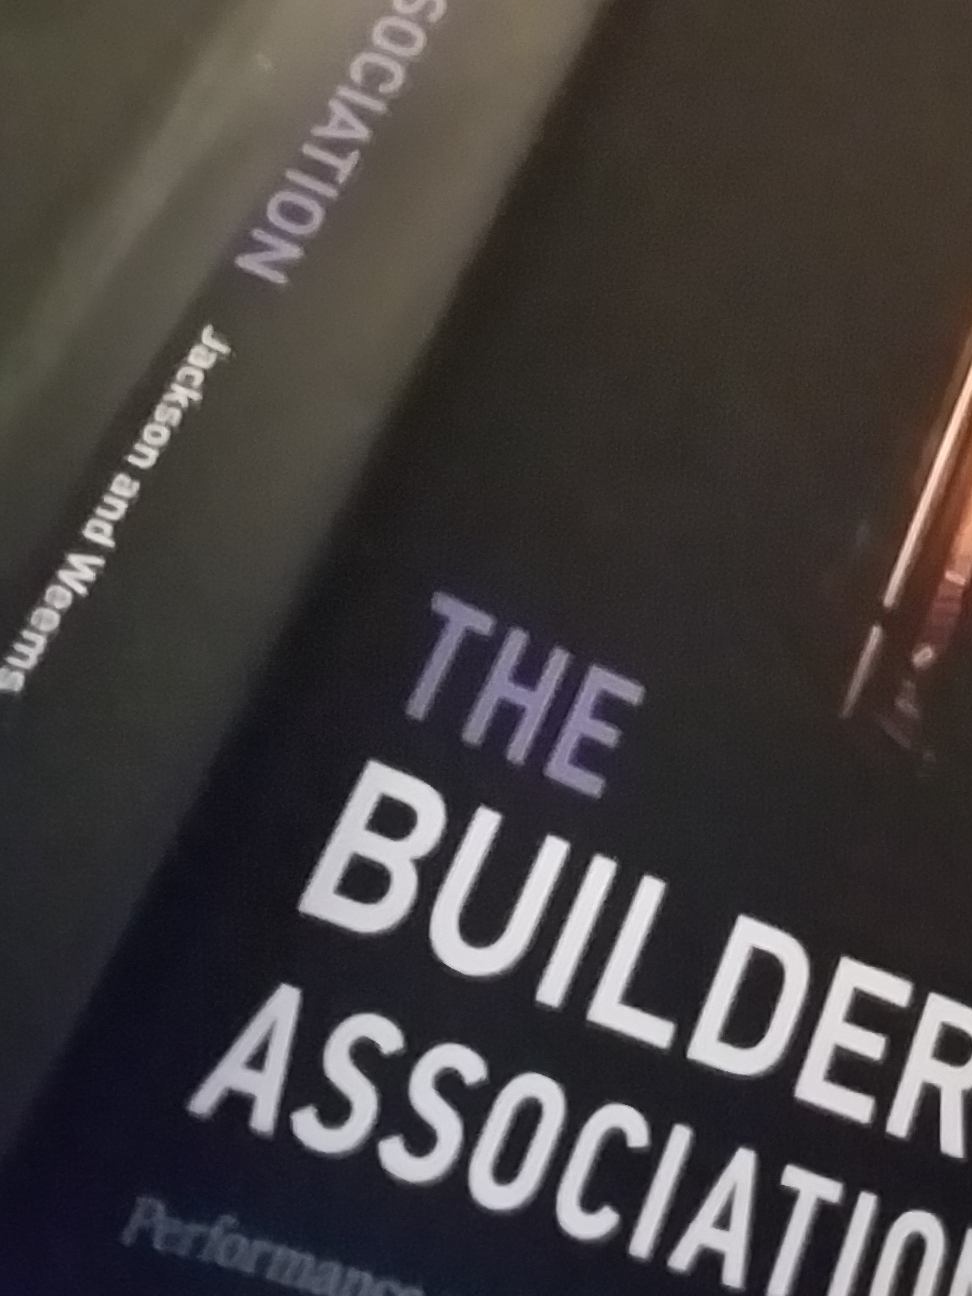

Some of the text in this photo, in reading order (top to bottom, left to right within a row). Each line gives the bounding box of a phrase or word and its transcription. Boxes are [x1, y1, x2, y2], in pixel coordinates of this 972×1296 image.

[0, 324, 232, 693] Jackson and Weems
[404, 590, 646, 799] THE
